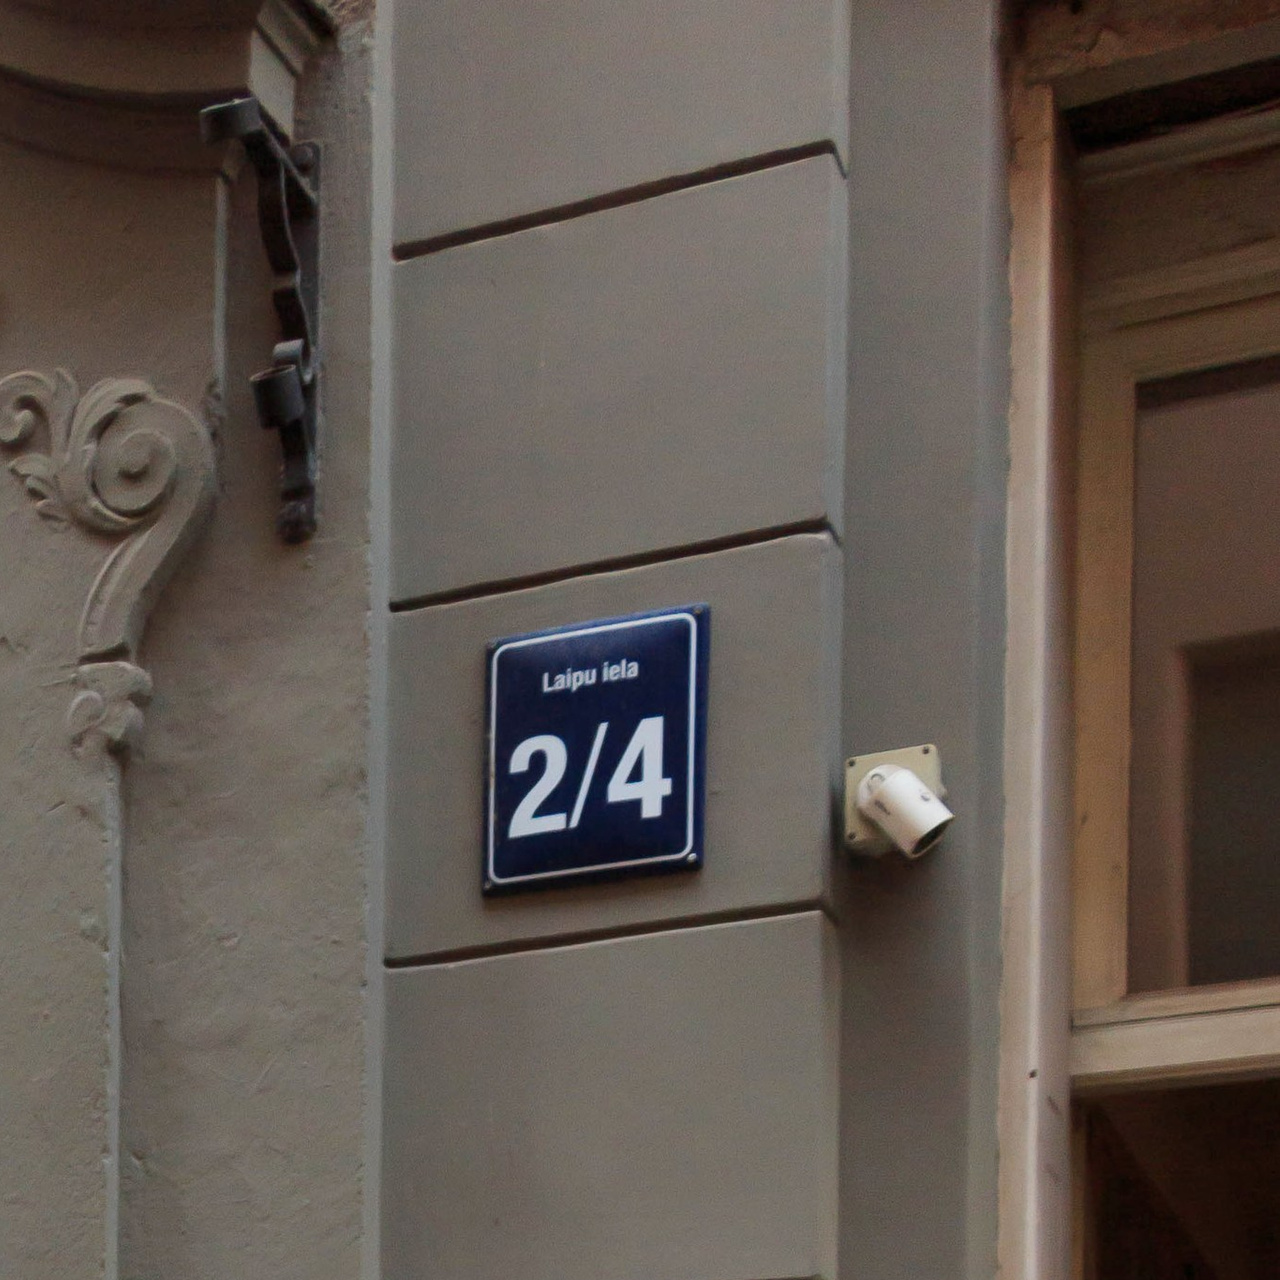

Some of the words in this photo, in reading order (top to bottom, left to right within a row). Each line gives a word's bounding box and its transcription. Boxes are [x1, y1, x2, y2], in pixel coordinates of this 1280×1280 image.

[542, 667, 597, 693] Laipu
[602, 658, 639, 682] iela
[508, 715, 673, 839] 2/4
